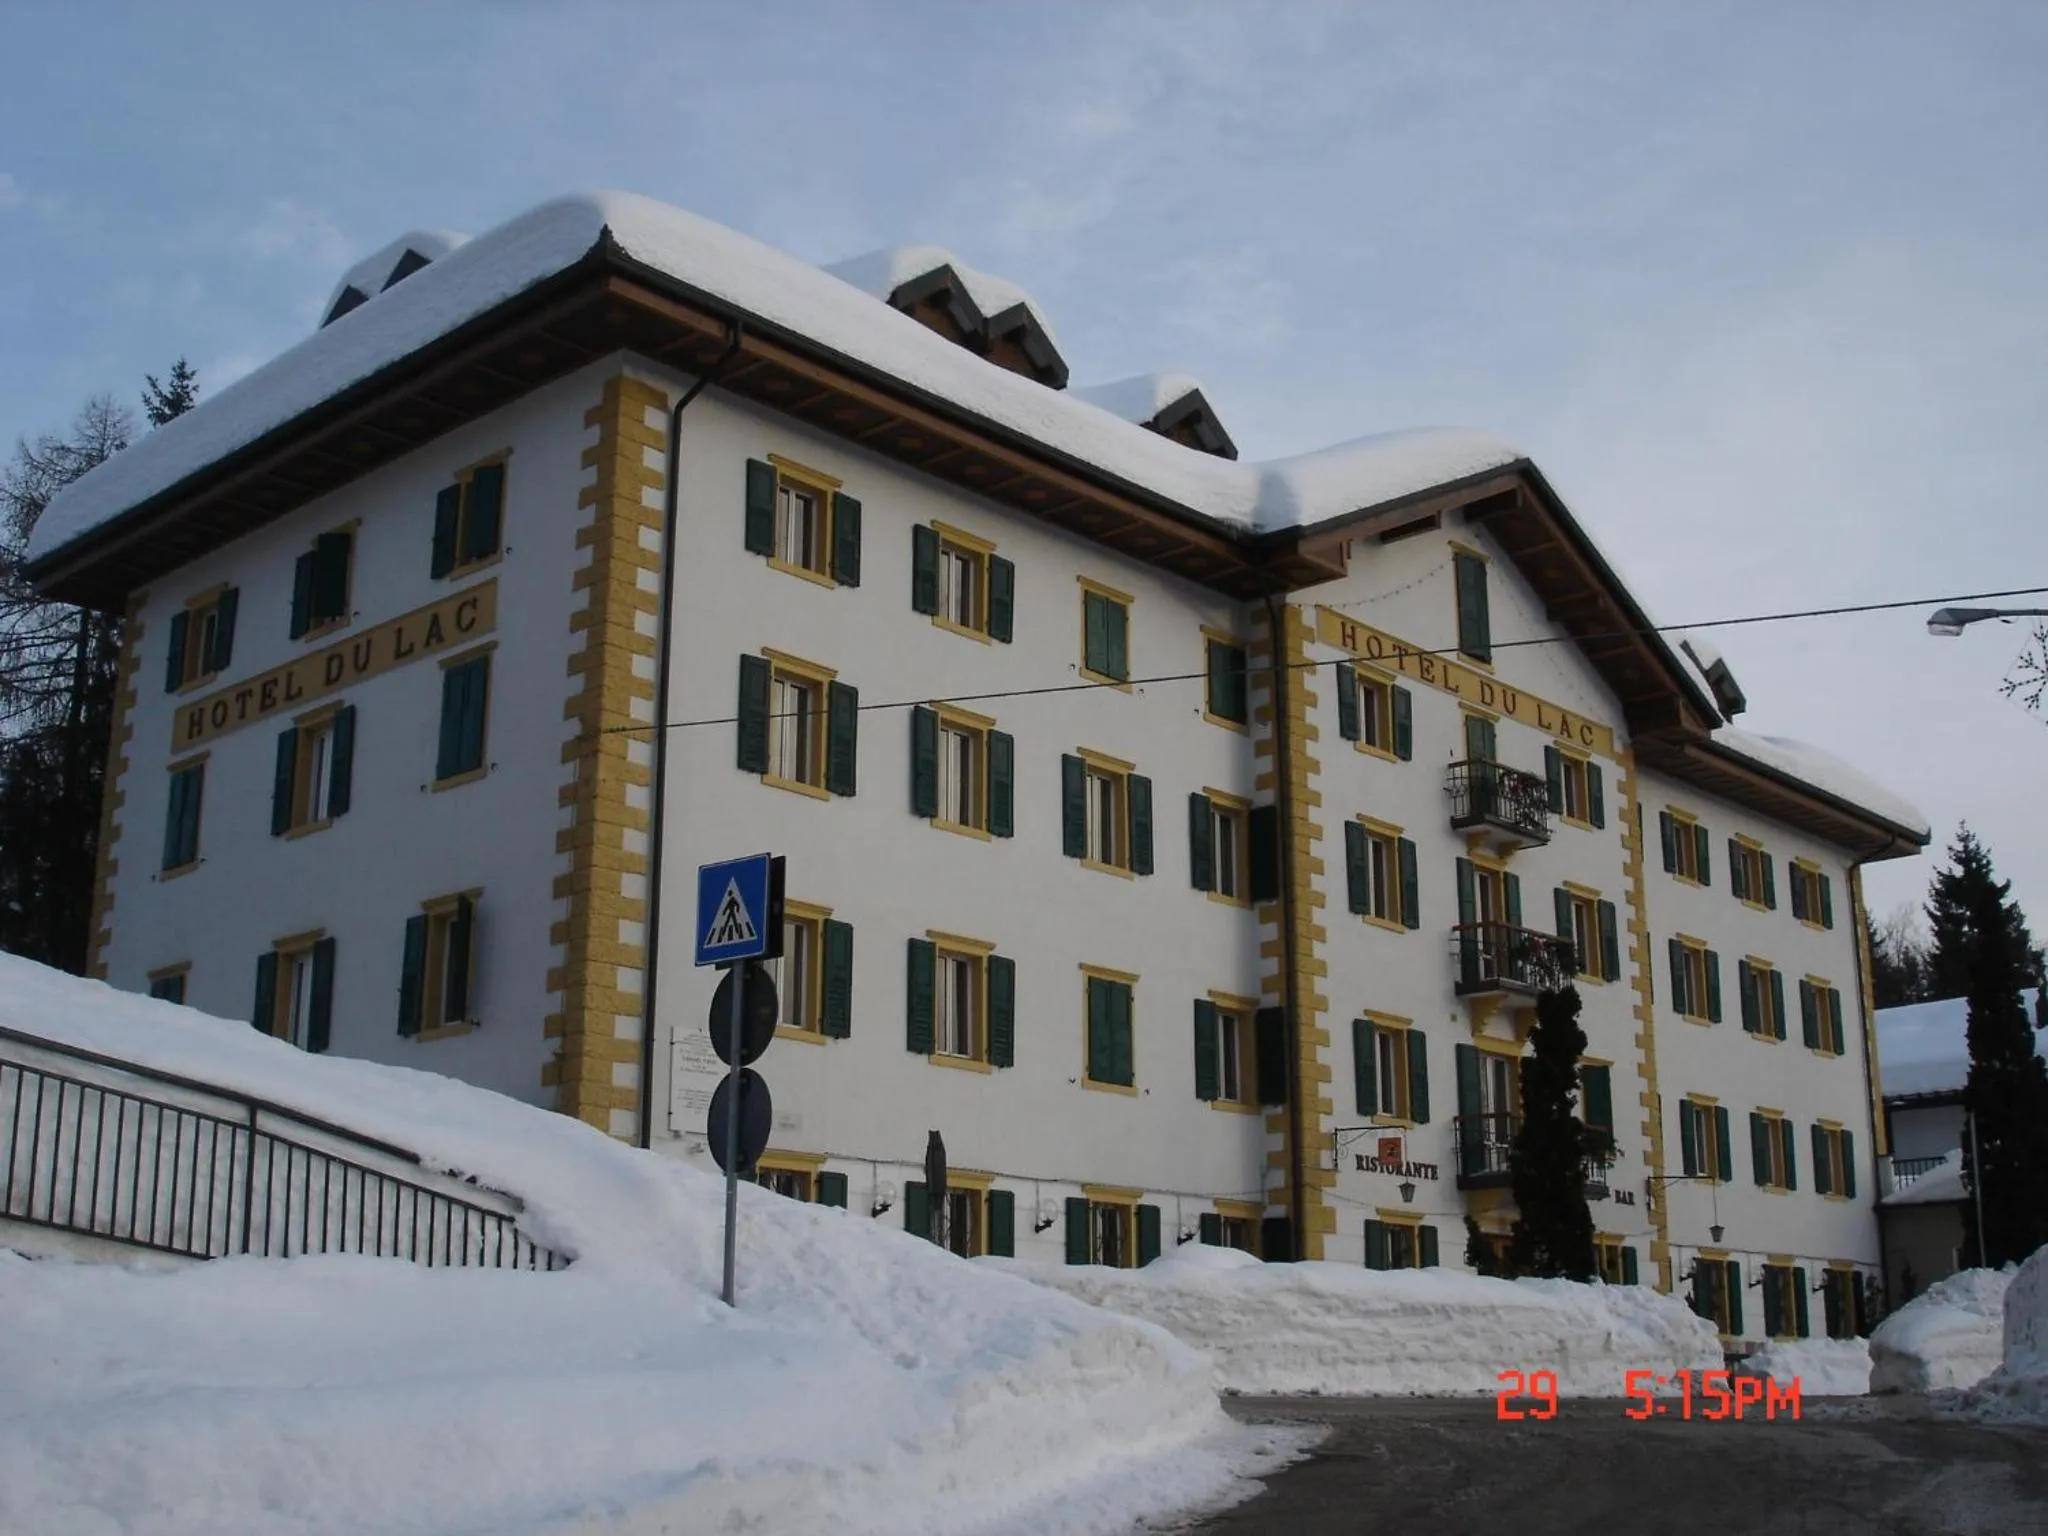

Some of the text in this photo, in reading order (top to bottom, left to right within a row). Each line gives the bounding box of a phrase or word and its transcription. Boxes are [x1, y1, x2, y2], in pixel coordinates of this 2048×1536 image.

[186, 597, 478, 740] HOTEL DU LAC
[1340, 620, 1594, 747] HOTEL DU LAC
[1355, 1154, 1439, 1181] RISTORANTE
[1614, 1189, 1635, 1205] BAR
